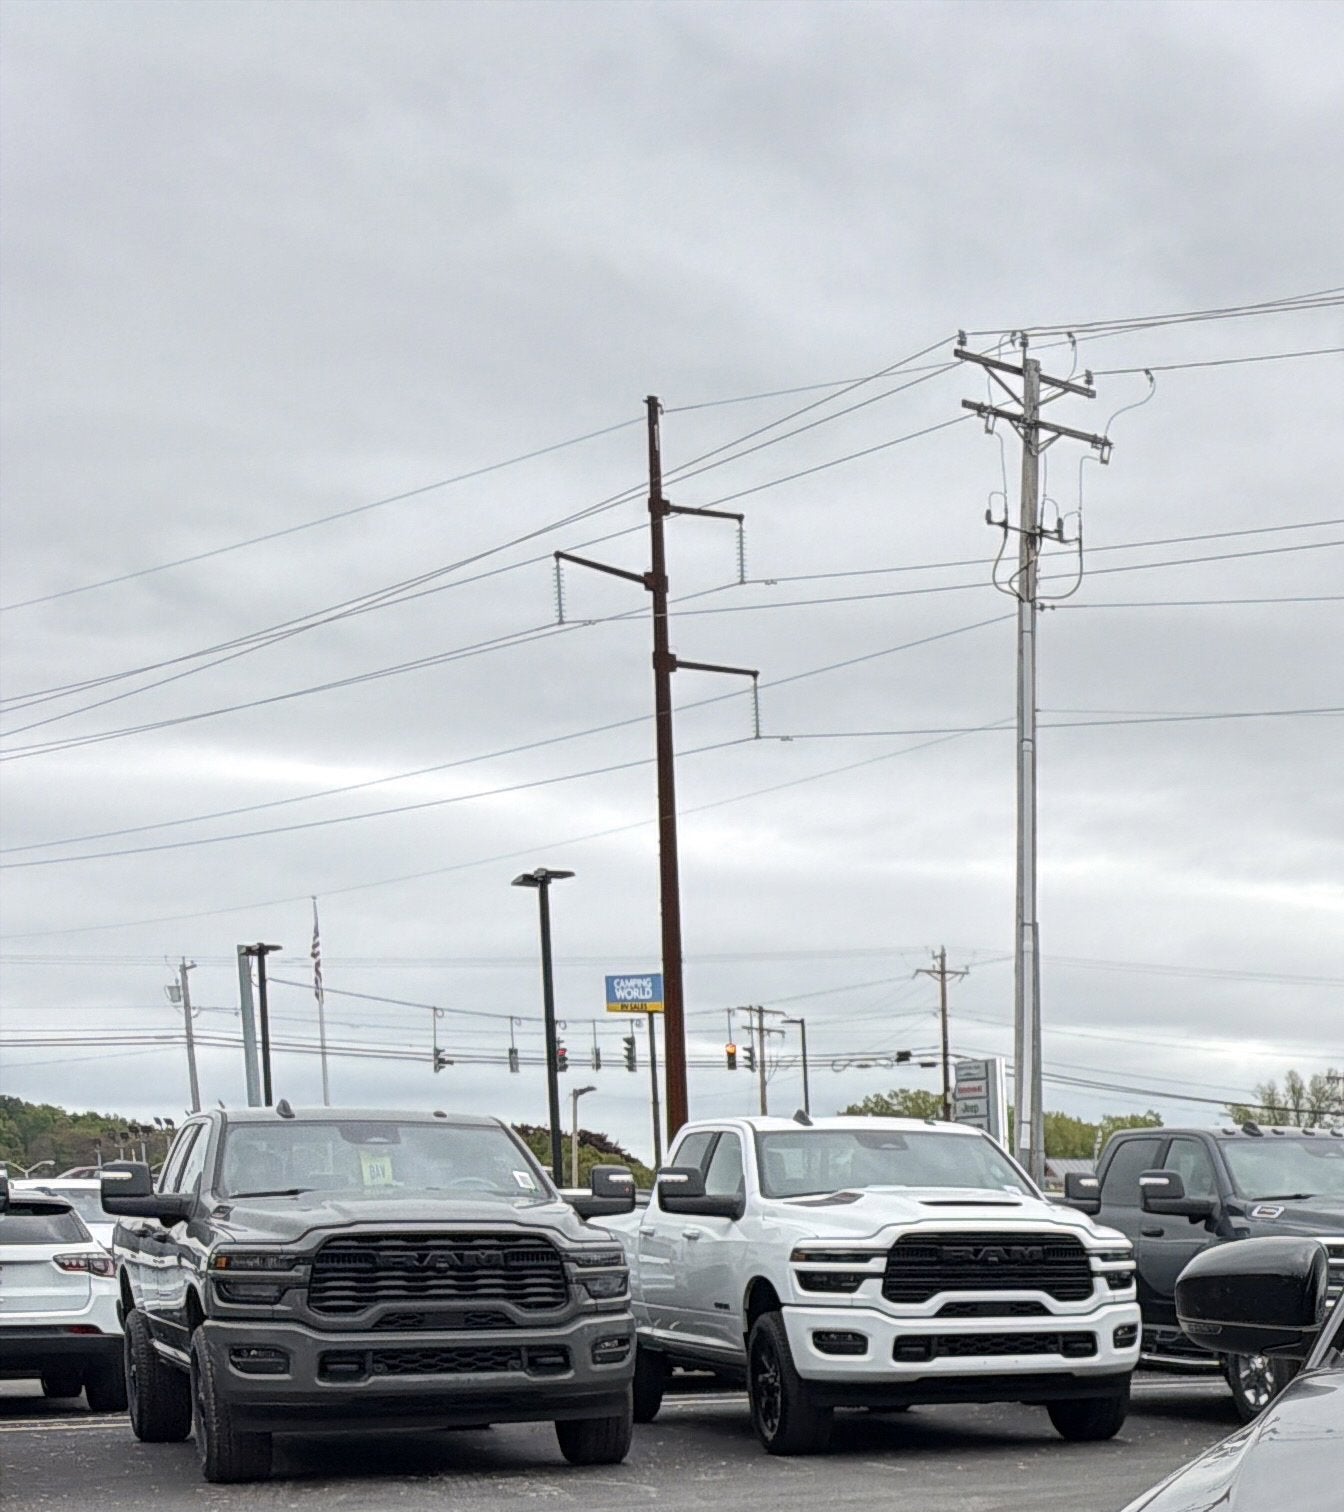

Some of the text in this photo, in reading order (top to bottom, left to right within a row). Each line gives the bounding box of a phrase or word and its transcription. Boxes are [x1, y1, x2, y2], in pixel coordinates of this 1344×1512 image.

[613, 978, 652, 989] CAMPING
[615, 987, 653, 1000] WORLD
[377, 1250, 505, 1268] RAM
